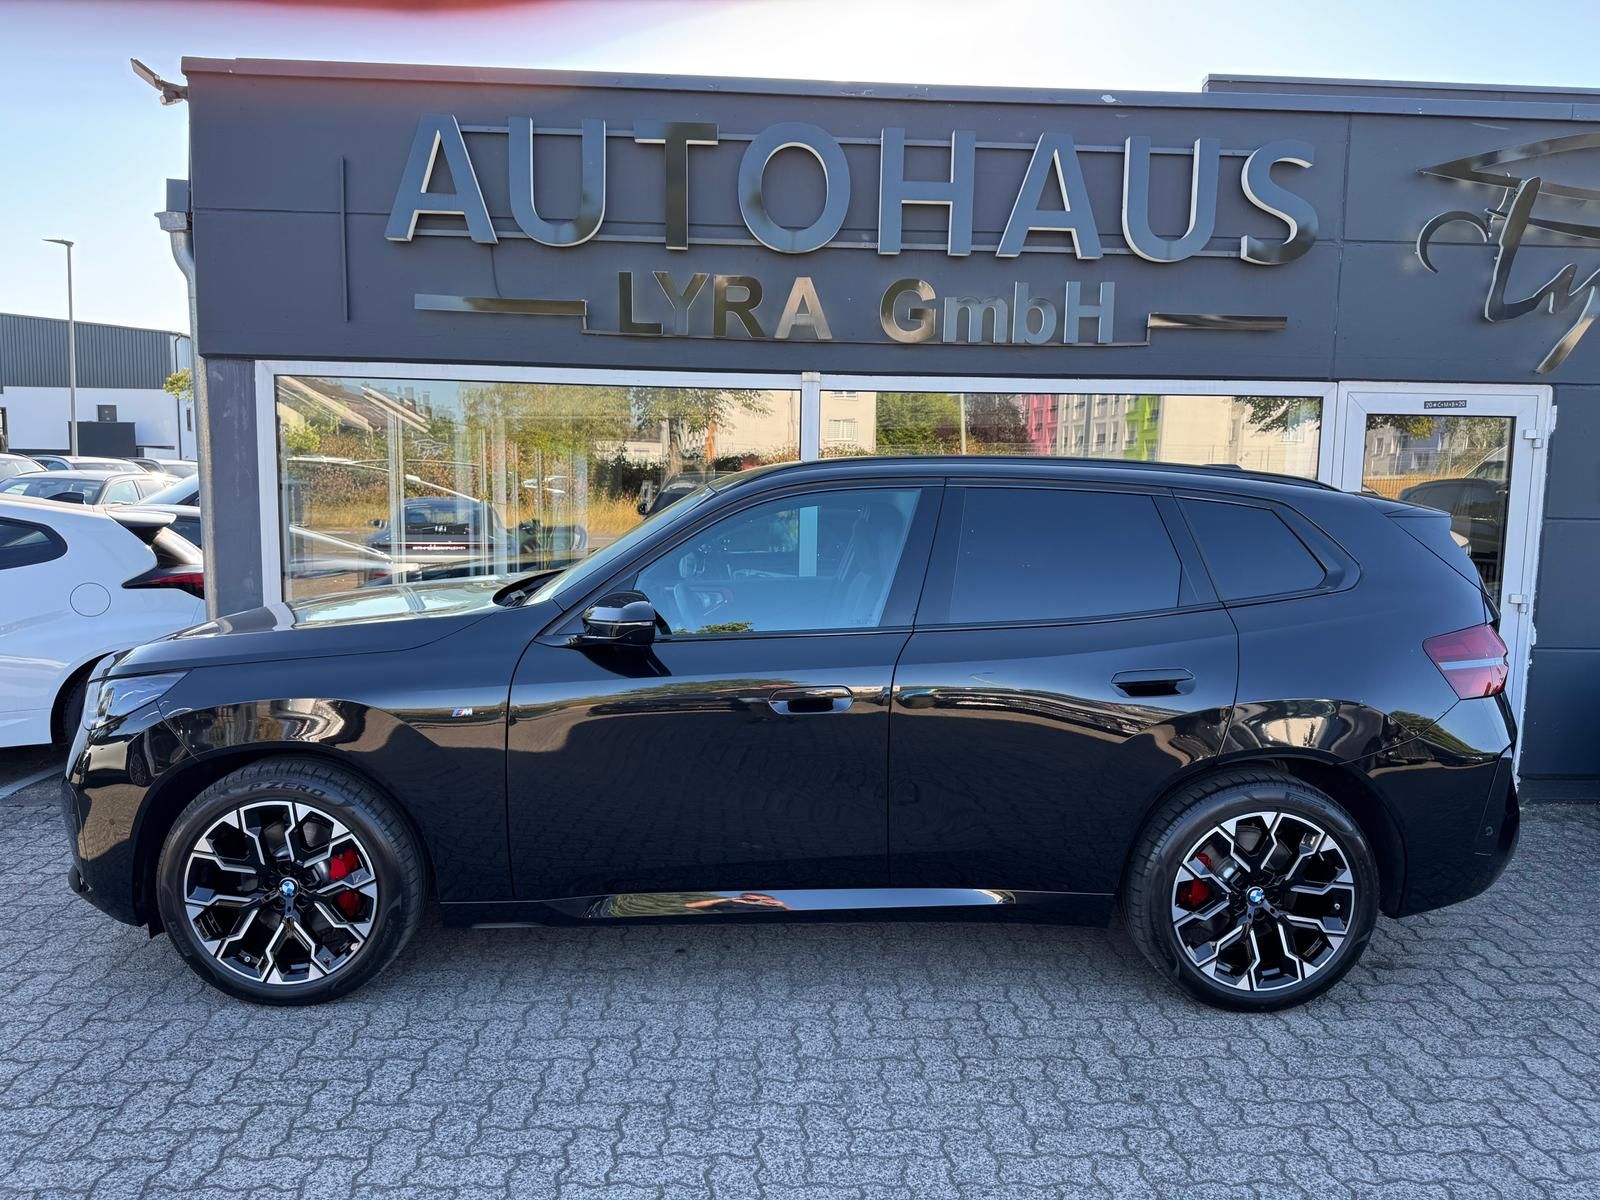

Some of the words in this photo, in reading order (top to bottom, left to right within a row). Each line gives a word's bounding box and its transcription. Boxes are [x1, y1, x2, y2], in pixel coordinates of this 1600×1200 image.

[384, 114, 1319, 265] AUTOHAUS
[617, 271, 832, 339] LYRA
[880, 278, 1115, 344] GmbH
[266, 781, 327, 797] ZERO
